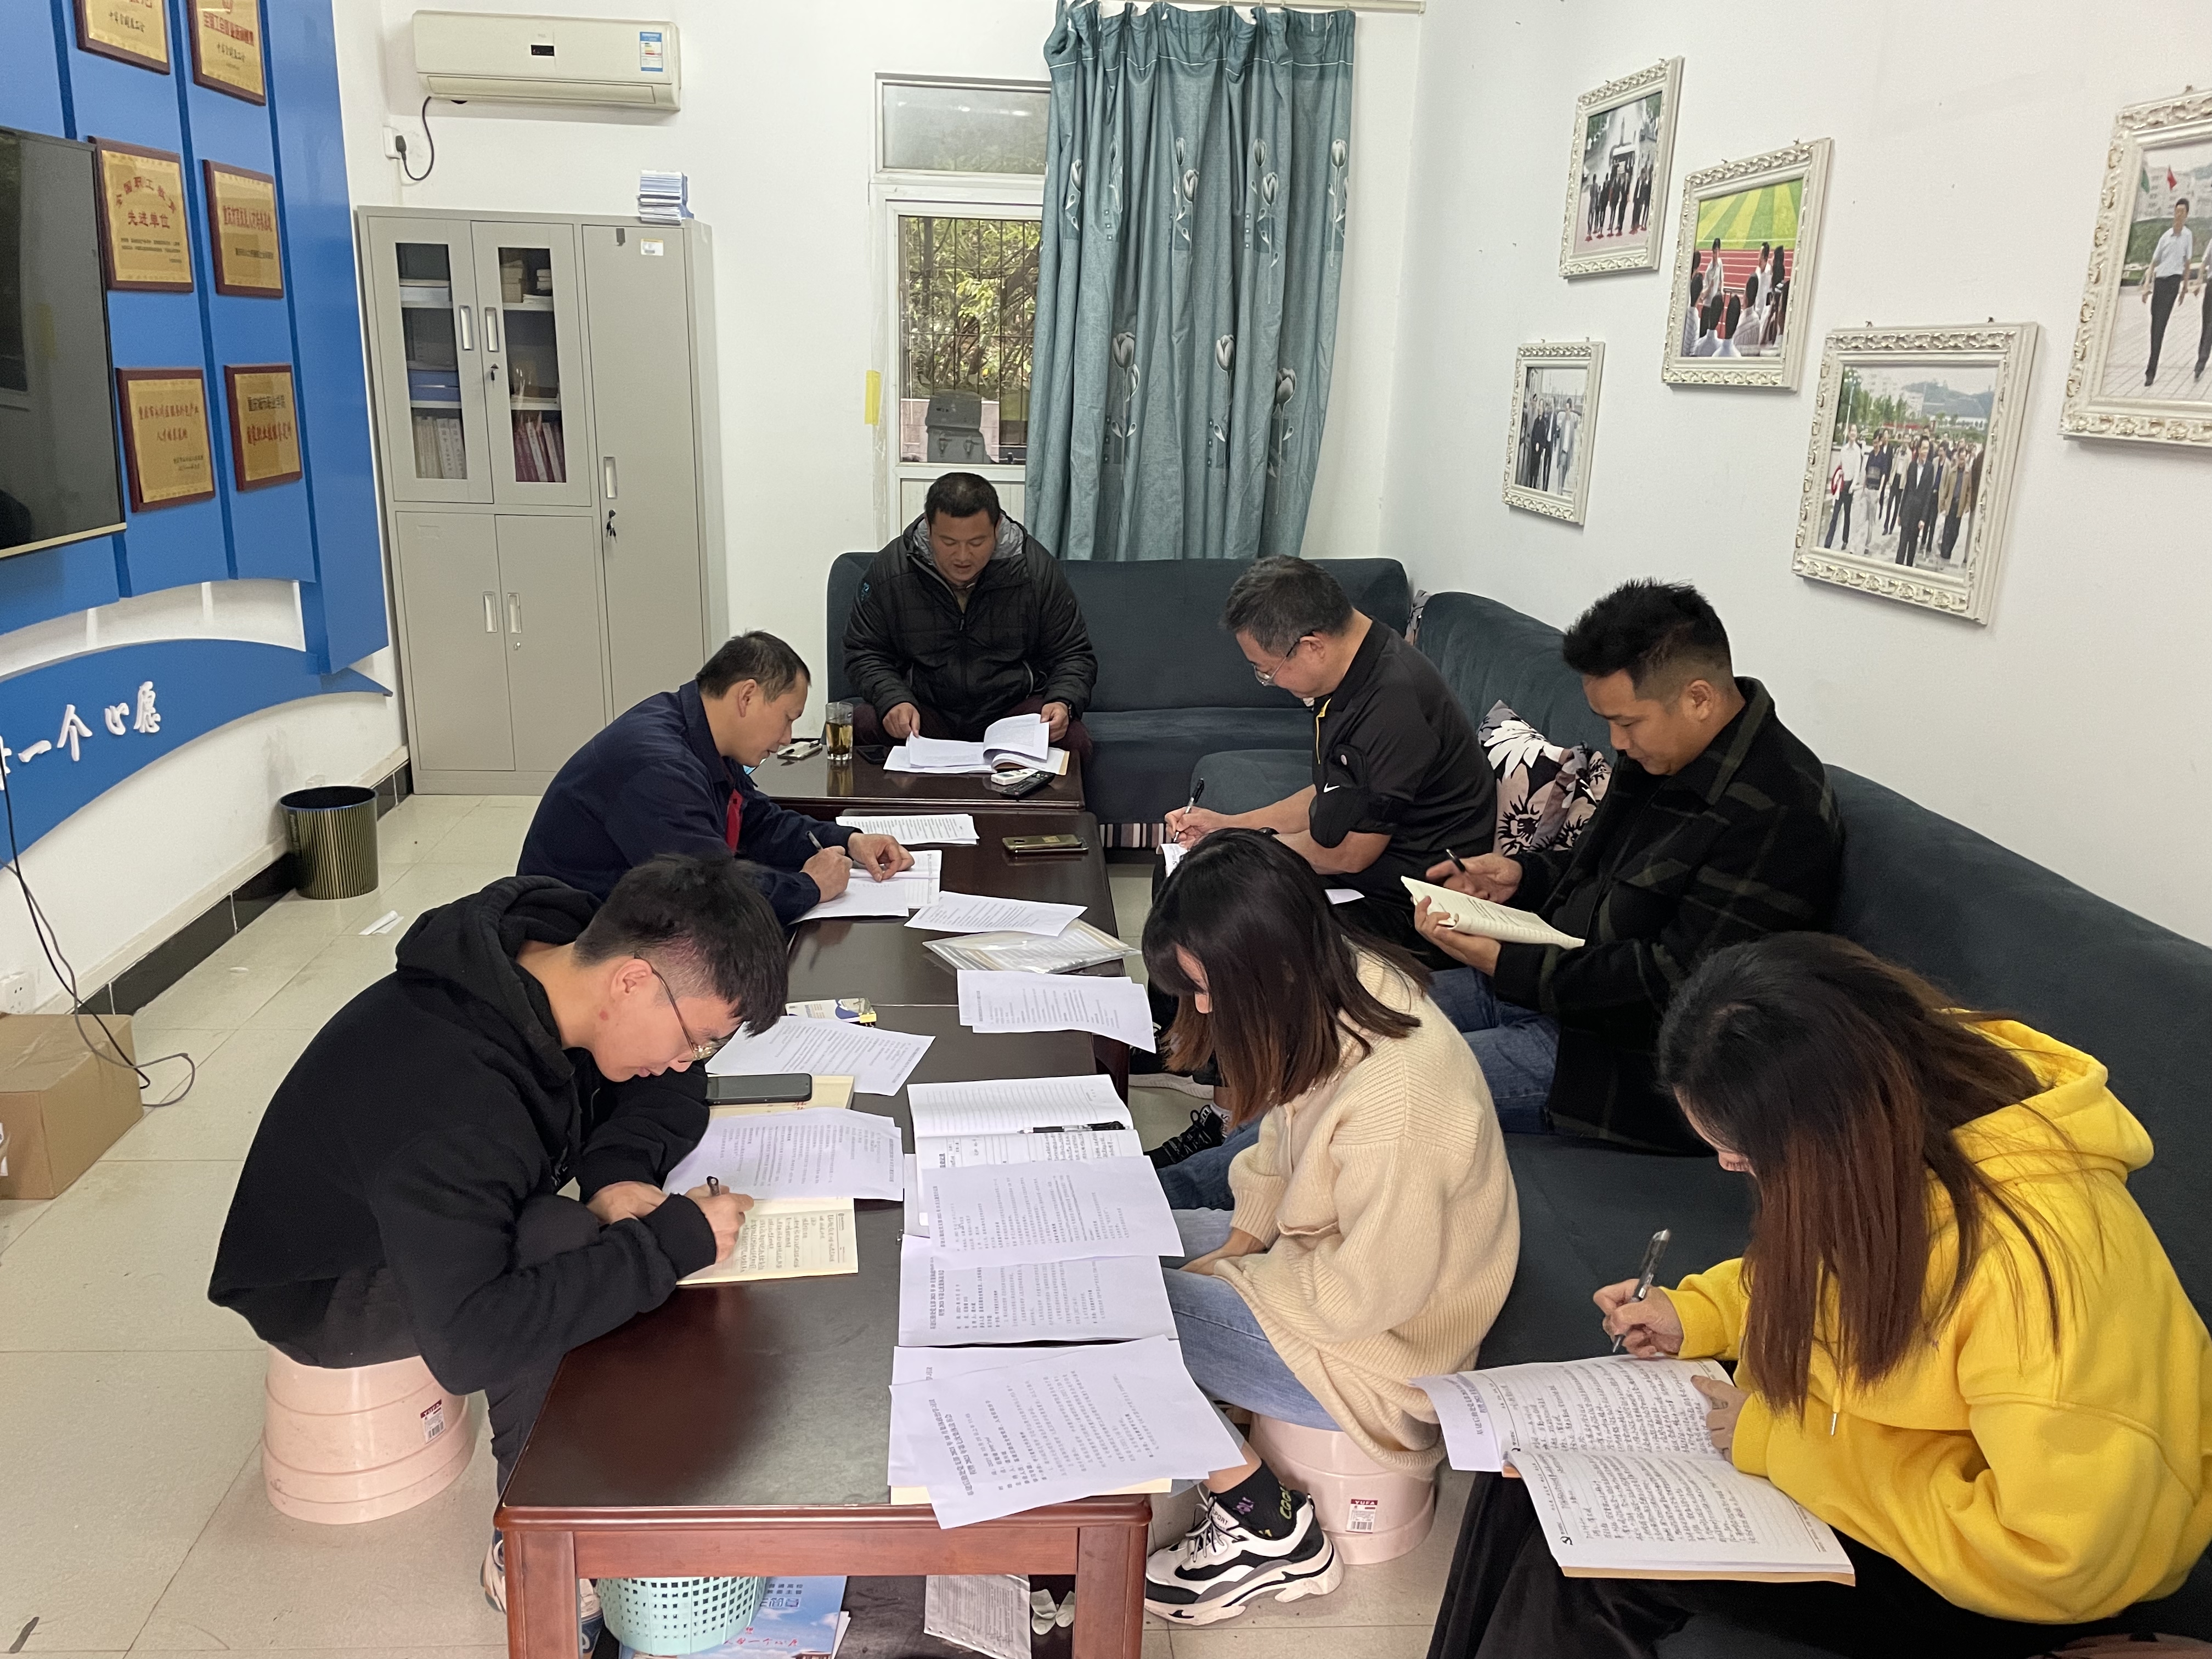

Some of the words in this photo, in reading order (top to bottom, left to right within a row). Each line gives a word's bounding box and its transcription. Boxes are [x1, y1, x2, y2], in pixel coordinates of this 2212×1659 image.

[128, 210, 170, 229] 先进单位
[0, 681, 161, 791] 一个心愿
